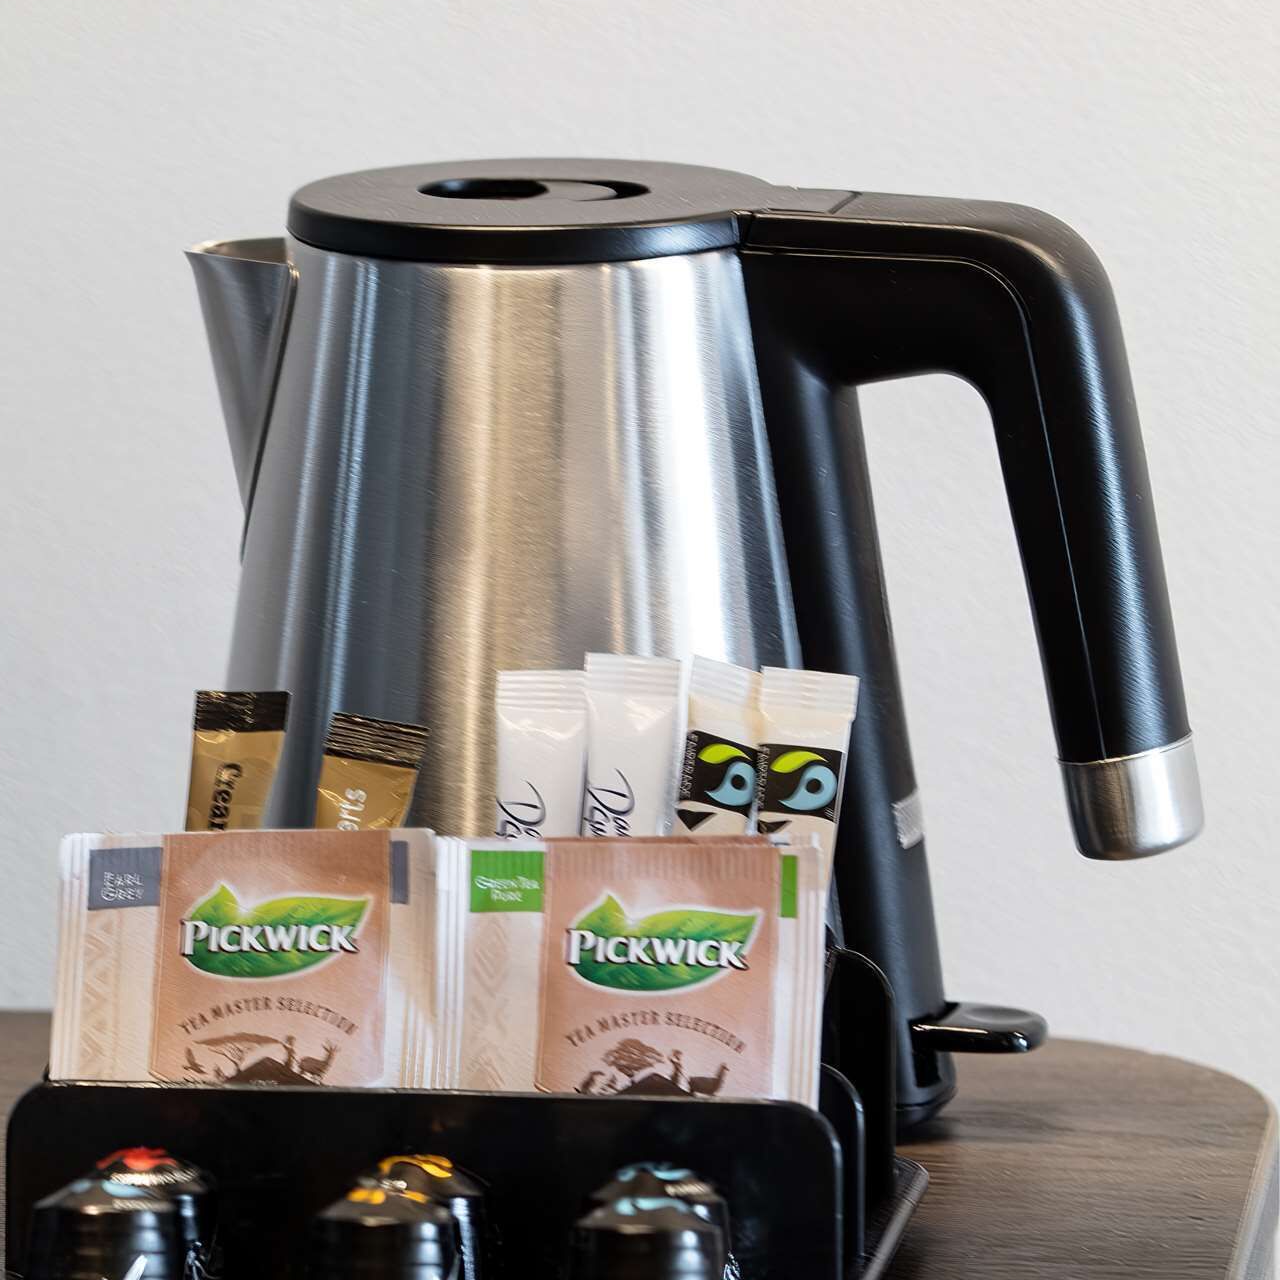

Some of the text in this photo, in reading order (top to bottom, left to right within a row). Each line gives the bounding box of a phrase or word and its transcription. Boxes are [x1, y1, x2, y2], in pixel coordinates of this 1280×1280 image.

[181, 919, 360, 956] PICKWICK
[566, 928, 749, 970] PICKWICK
[177, 995, 359, 1036] TEA MASTER SELECTION
[564, 1009, 748, 1054] TEA MASTER SELECTION
